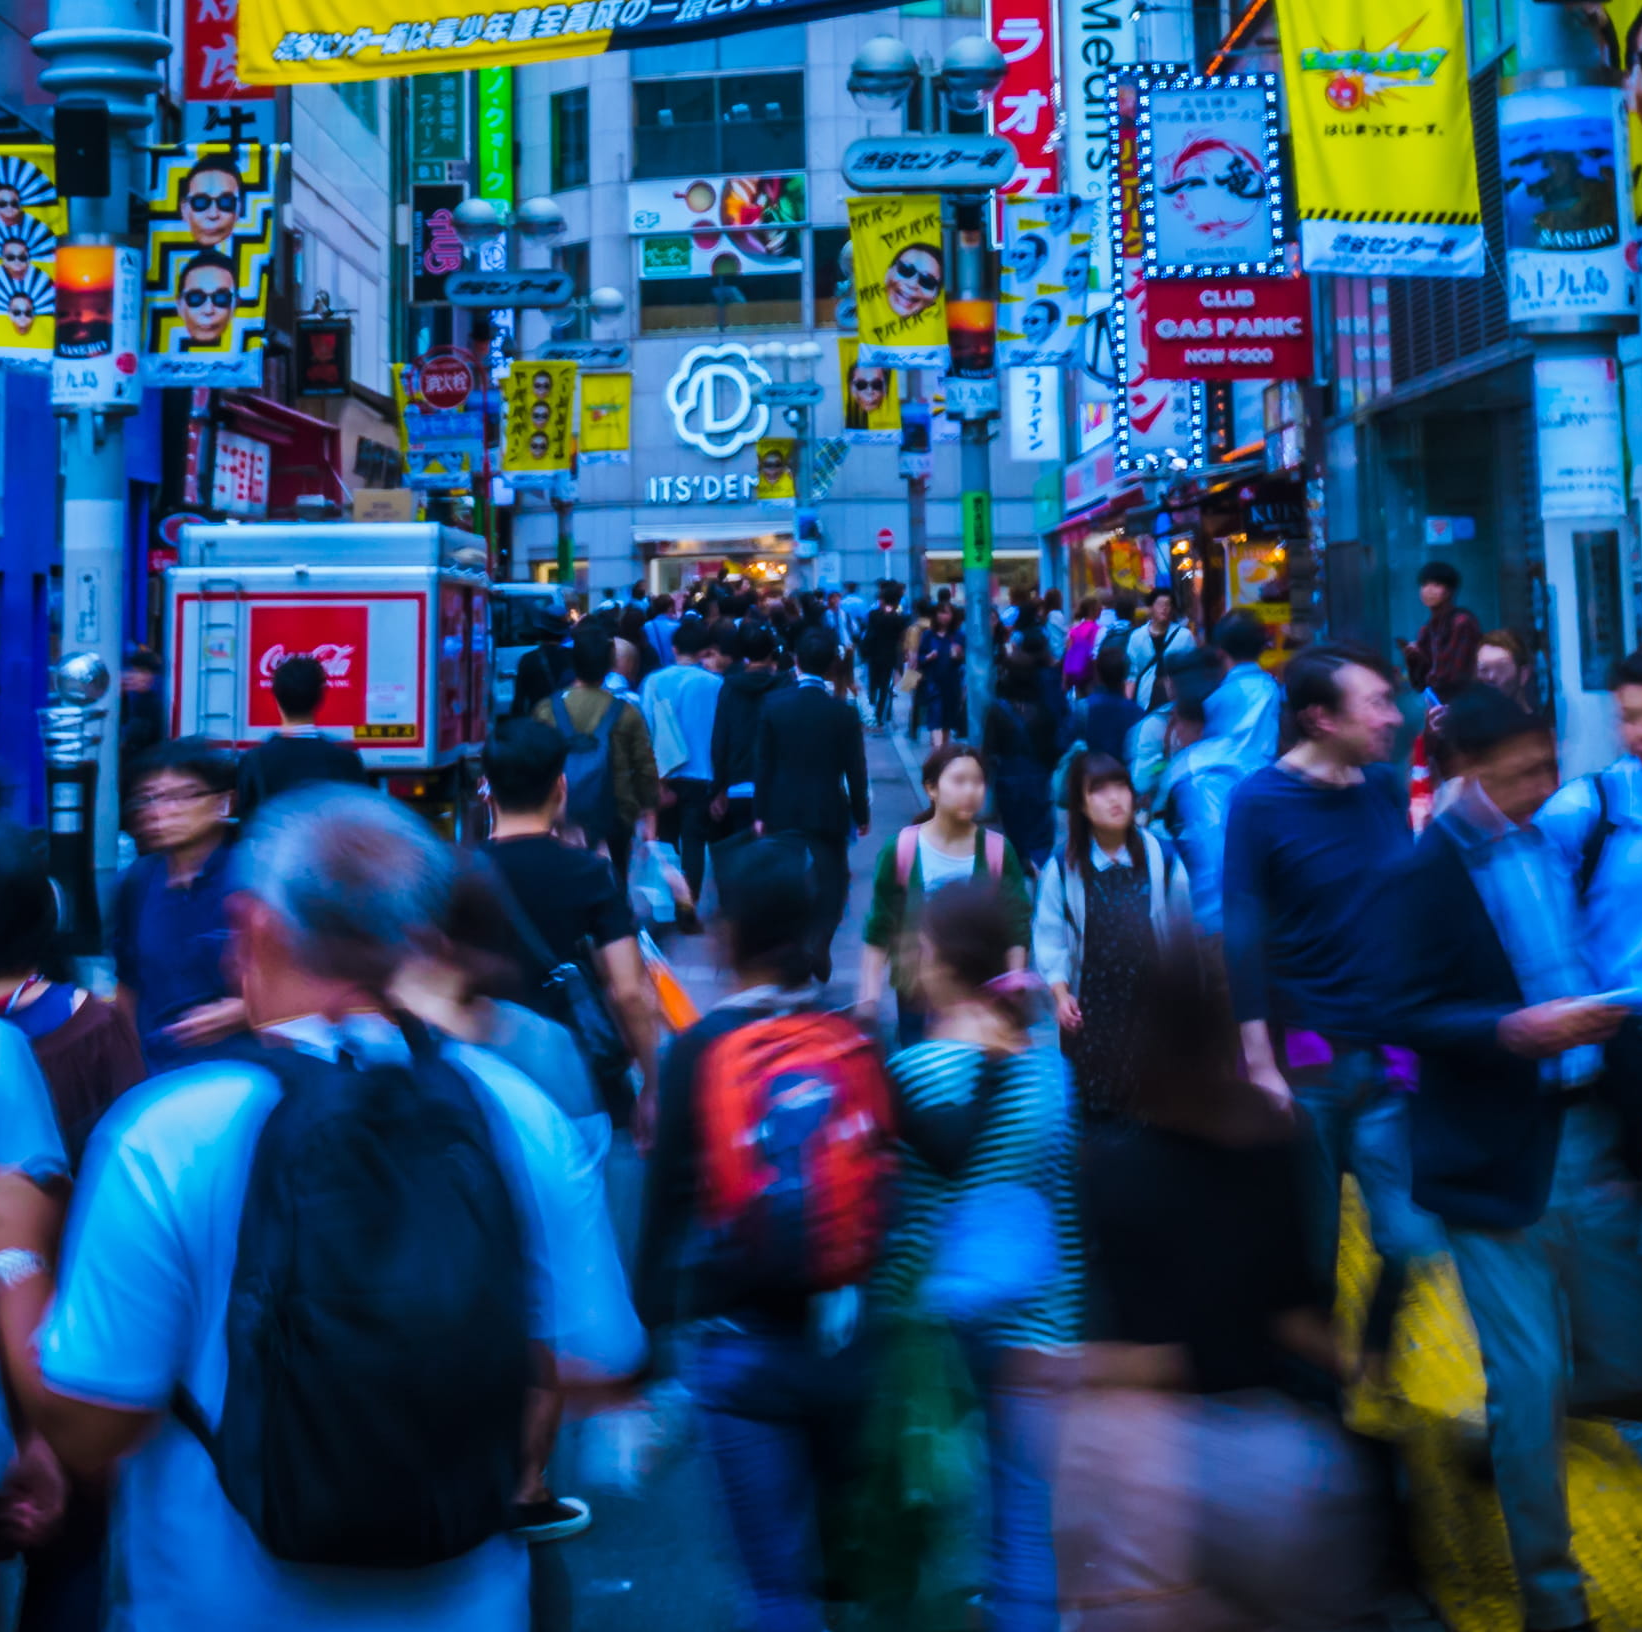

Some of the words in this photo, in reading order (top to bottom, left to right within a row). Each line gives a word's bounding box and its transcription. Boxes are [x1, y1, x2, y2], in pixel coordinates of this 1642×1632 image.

[854, 149, 1007, 170] 渋谷センター街
[1200, 290, 1255, 308] CLUB
[1155, 319, 1213, 339] GAS
[1217, 317, 1303, 338] PANIC
[1184, 348, 1225, 364] NOW
[425, 372, 468, 393] 消火栓
